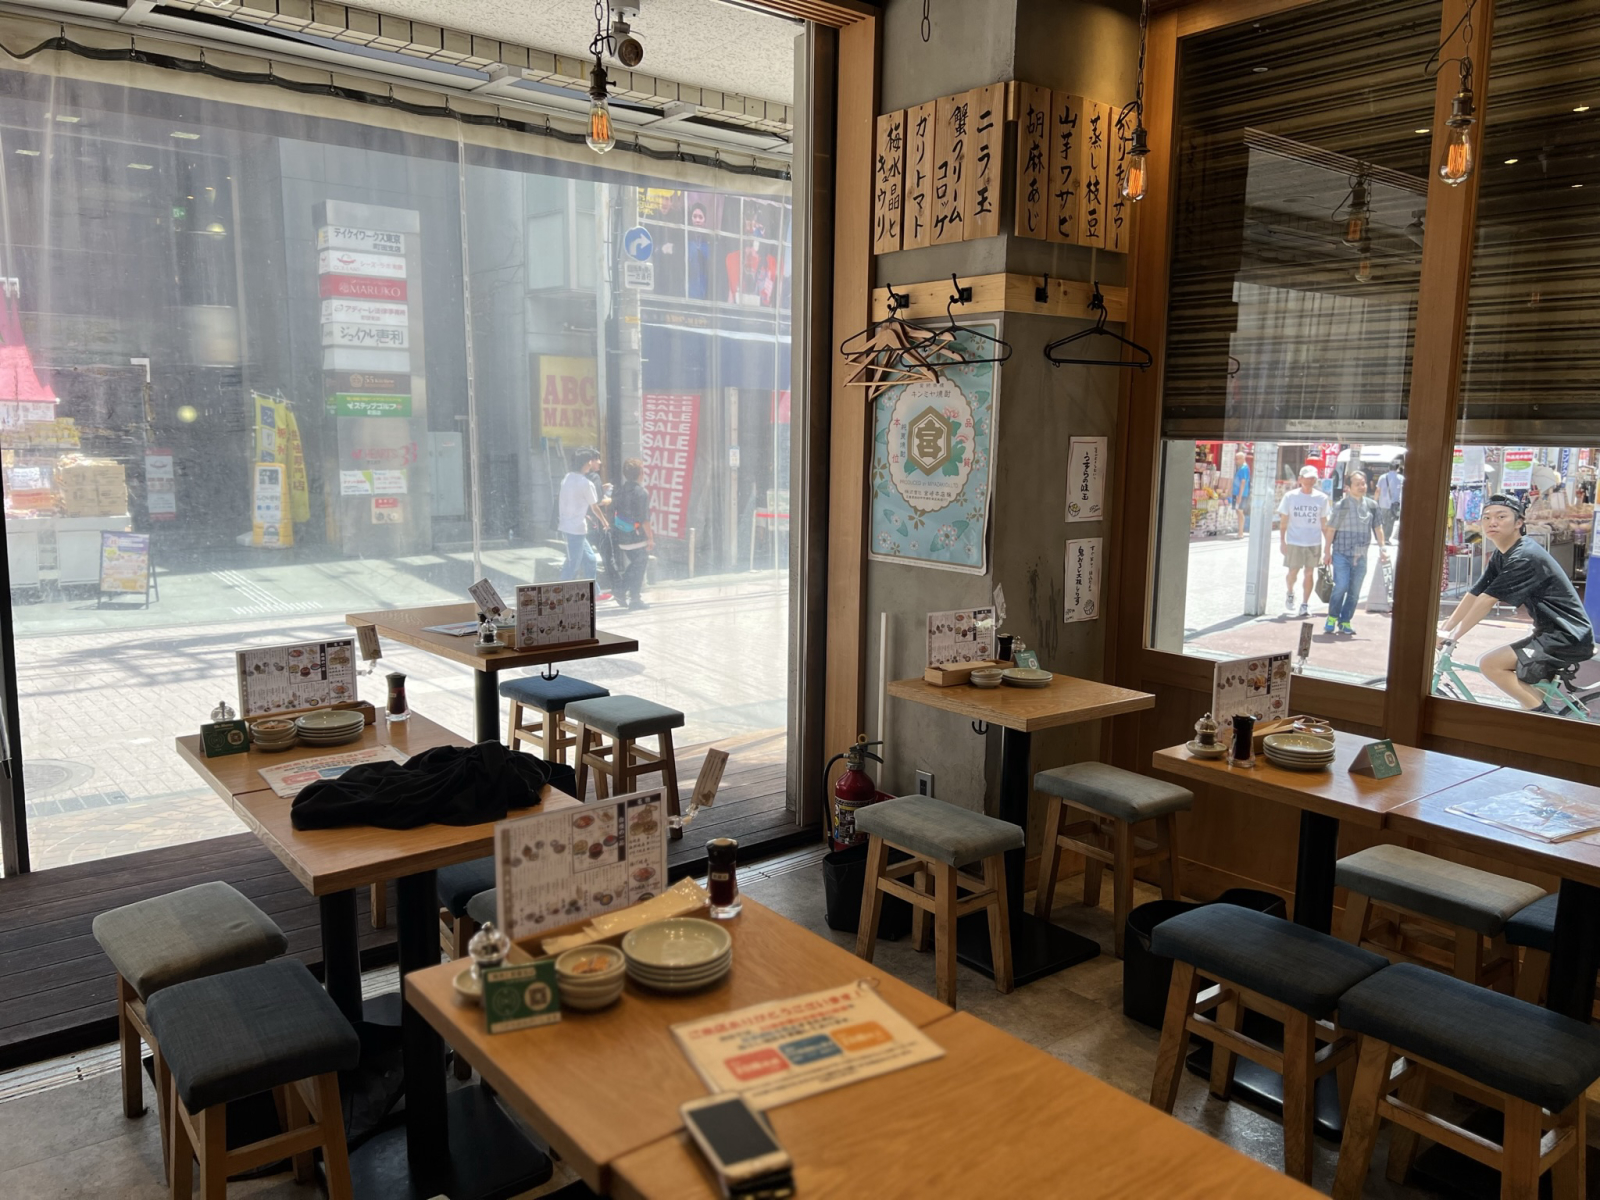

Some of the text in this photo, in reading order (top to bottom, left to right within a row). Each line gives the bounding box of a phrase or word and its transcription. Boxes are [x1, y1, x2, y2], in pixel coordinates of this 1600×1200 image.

[912, 114, 931, 239] ガリトマト
[973, 110, 996, 217] ニラ玉
[1024, 103, 1046, 233] 胡麻あじ
[1055, 105, 1078, 238] 山芋ワサビ
[1083, 114, 1101, 239] 蒸し枝豆
[887, 122, 902, 239] 梅水晶と
[877, 154, 888, 242] キュウリ
[933, 160, 949, 240] コロッケ
[350, 284, 401, 297] MARUKO
[543, 375, 595, 406] ABC
[911, 390, 952, 399] キンミヤ焼酎
[543, 407, 596, 427] MART
[645, 404, 693, 412] SALE
[645, 411, 692, 422] SALE
[643, 421, 691, 434] SALE
[642, 433, 690, 450] SALE
[642, 449, 688, 469] SALE
[648, 489, 683, 513] ALE
[649, 511, 680, 538] ALE
